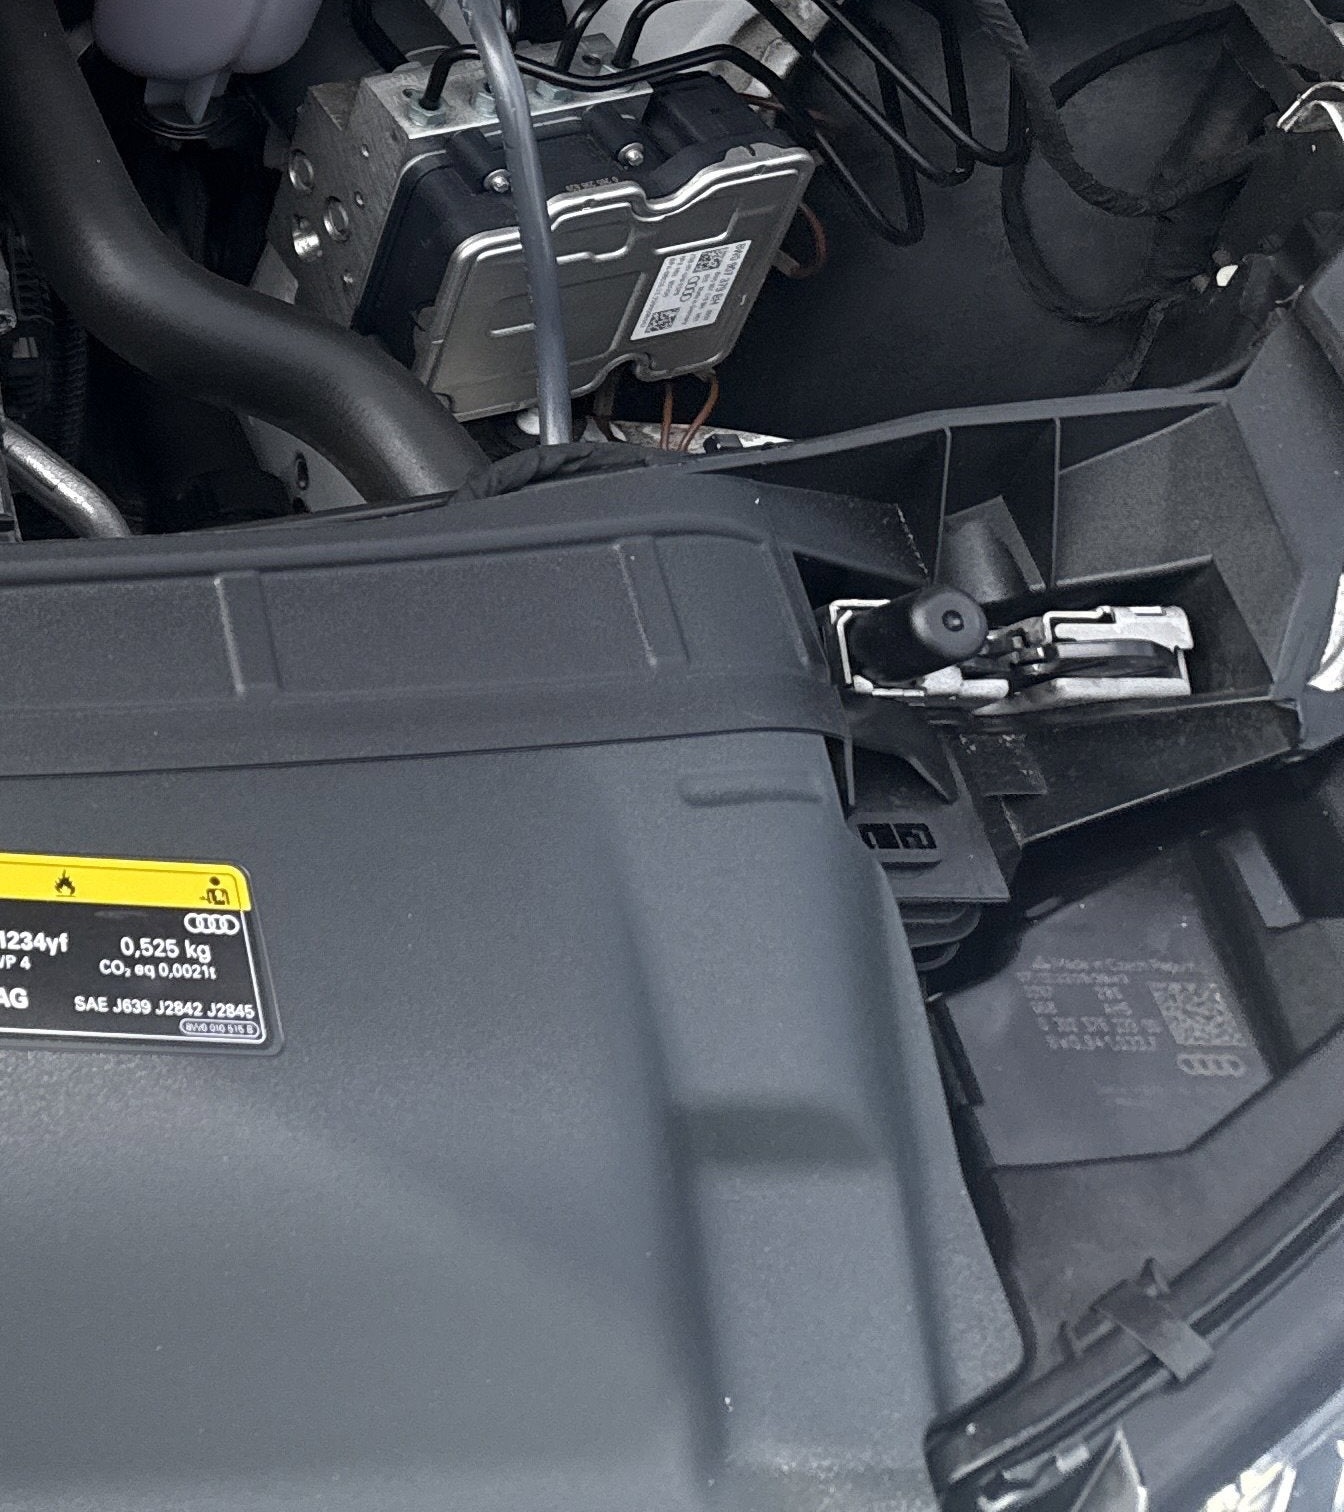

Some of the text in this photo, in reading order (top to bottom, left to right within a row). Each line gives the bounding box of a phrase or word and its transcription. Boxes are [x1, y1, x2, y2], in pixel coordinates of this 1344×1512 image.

[120, 936, 212, 964] 0,525 kg
[19, 955, 32, 971] 4
[134, 963, 156, 980] eq
[158, 962, 217, 981] 0,0021t
[73, 995, 256, 1020] SAE J639 J2842 J2845
